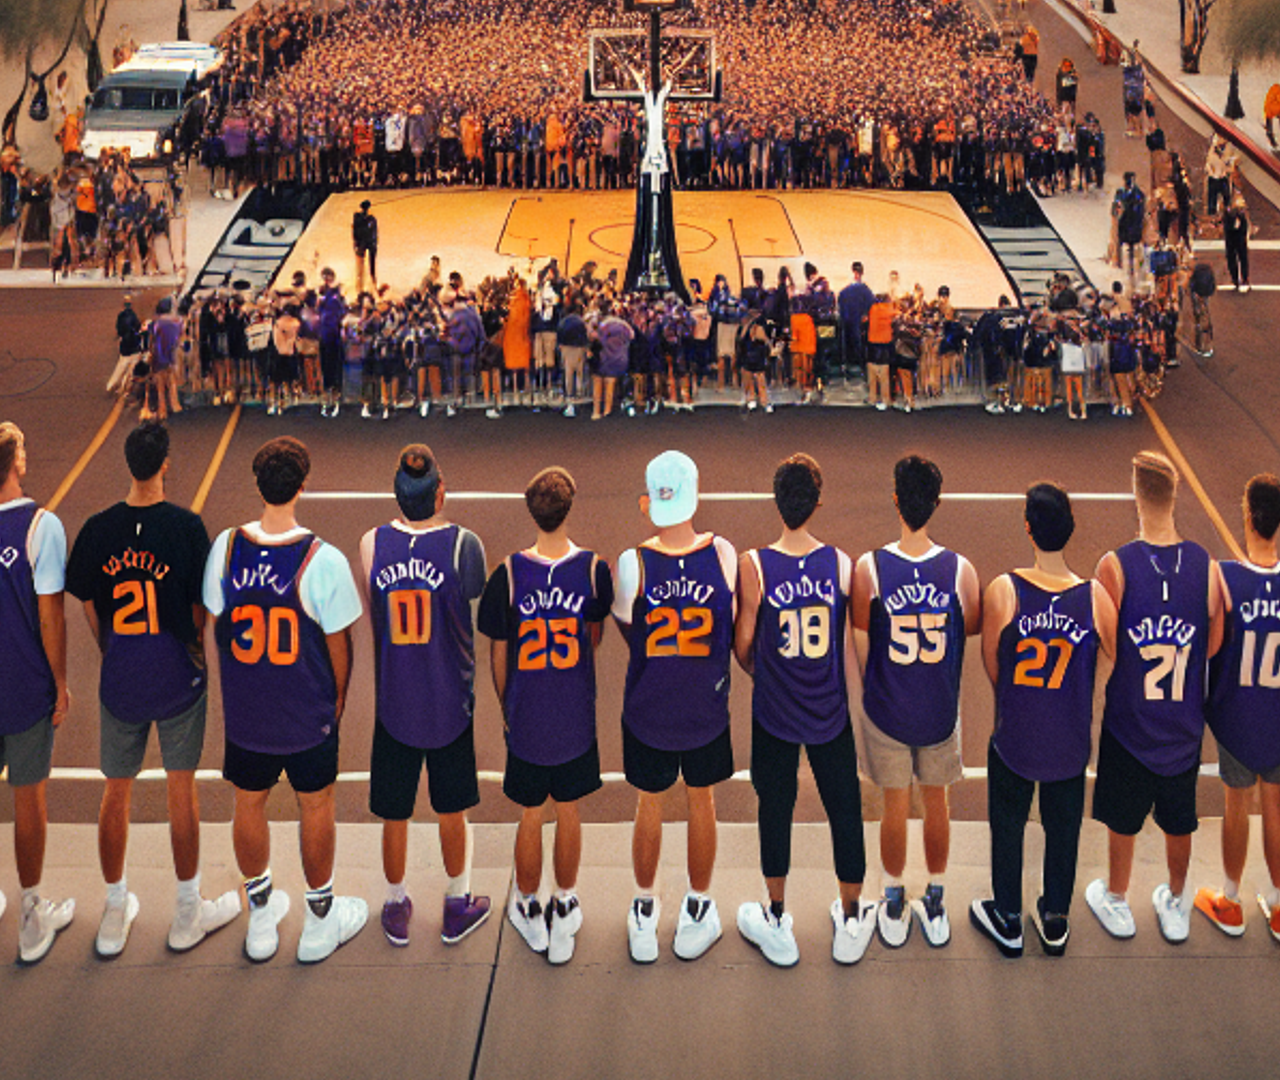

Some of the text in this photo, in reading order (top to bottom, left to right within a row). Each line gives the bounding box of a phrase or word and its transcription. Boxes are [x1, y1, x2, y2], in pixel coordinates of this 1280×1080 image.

[113, 580, 160, 635] 21
[645, 606, 712, 657] 22
[230, 604, 300, 666] 30
[518, 617, 579, 670] 25
[888, 613, 949, 665] 55
[1013, 637, 1074, 689] 27
[1140, 643, 1192, 702] 21
